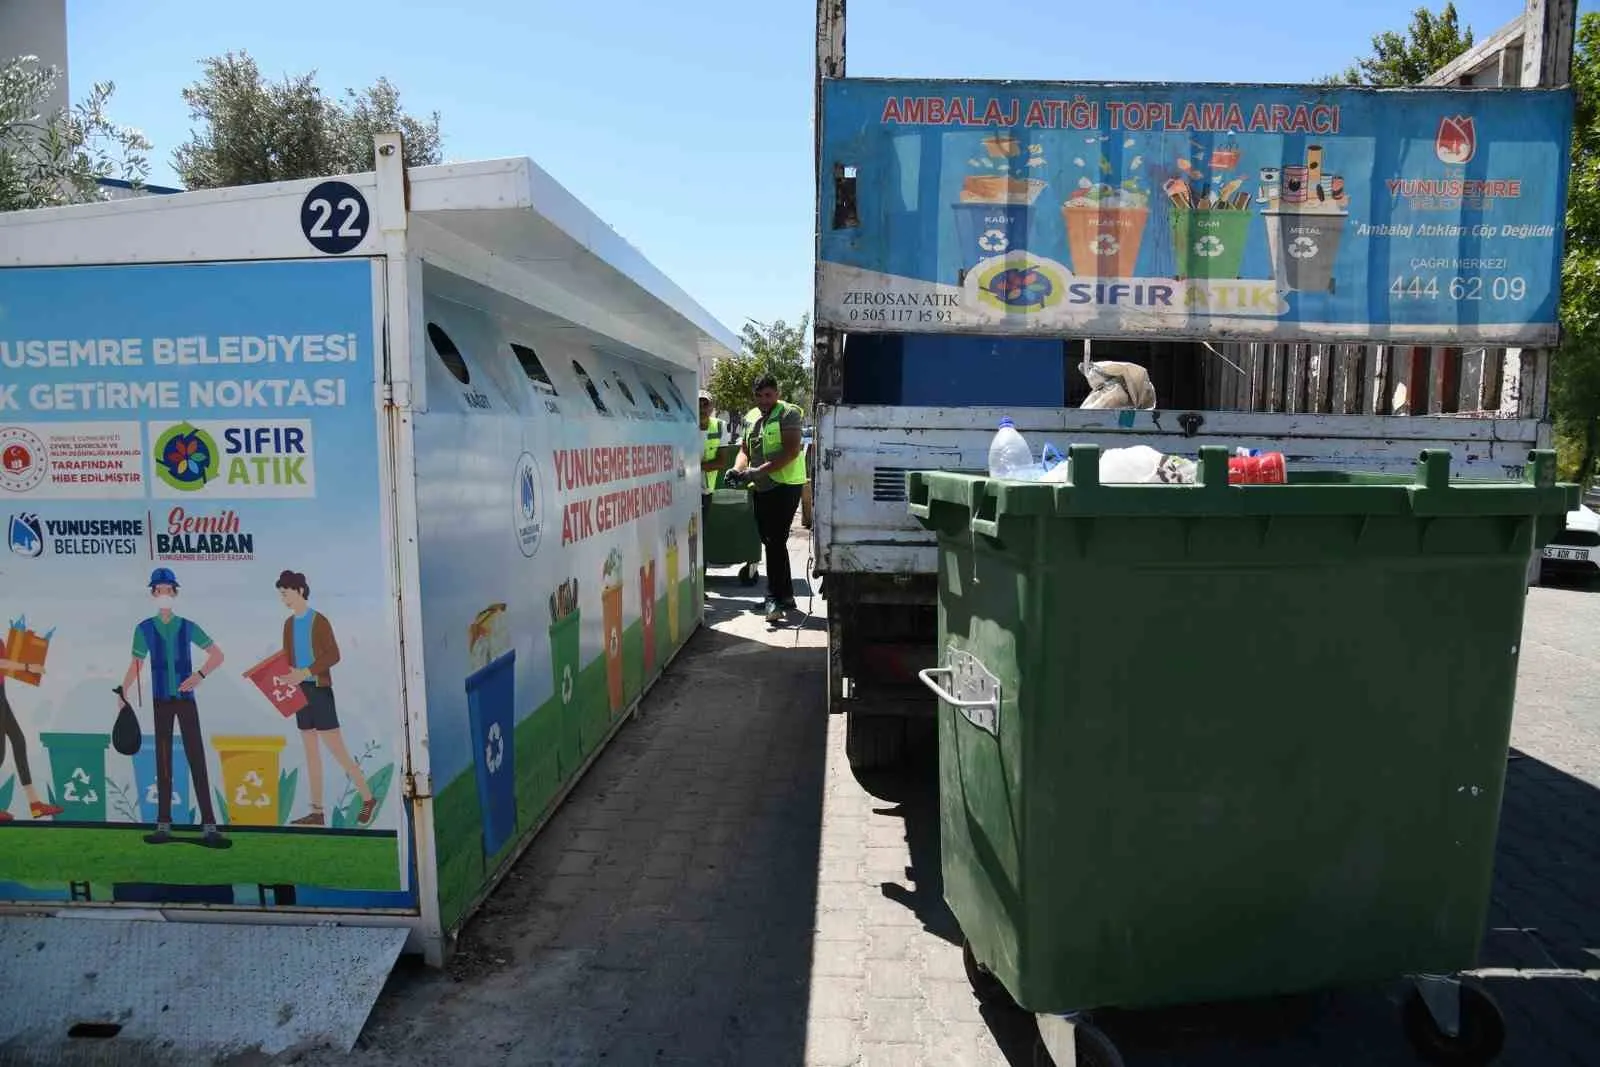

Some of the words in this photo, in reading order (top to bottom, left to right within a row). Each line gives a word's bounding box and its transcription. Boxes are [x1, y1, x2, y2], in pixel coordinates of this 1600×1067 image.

[880, 96, 1020, 127] AMBALAJ
[1024, 95, 1098, 130] ATIĞI
[1107, 101, 1243, 133] TOPLAMA
[1248, 103, 1341, 134] ARACI
[1386, 179, 1521, 198] YUNUSEMRE
[308, 198, 362, 238] 22
[843, 291, 920, 306] ZEROSAN
[922, 293, 960, 306] ATIK
[1069, 283, 1174, 306] SIFIR
[1184, 286, 1277, 307] ATIK
[1390, 275, 1440, 300] 444
[1449, 276, 1482, 300] 62
[1492, 276, 1526, 301] 09
[862, 309, 885, 321] 505
[891, 310, 913, 321] 117
[936, 310, 952, 321] 93
[0, 338, 143, 368] USEMRE
[153, 333, 357, 365] BELEDİYESİ
[29, 380, 180, 411] GETİRME
[190, 378, 346, 408] NOKTASI
[225, 427, 305, 454] SIFIR
[52, 460, 123, 470] TARAFINDAN
[52, 473, 78, 483] HİBE
[81, 471, 141, 483] EDİLMİŞTİR
[227, 456, 307, 485] ATIK
[553, 445, 630, 492] YUNUSEMRE
[46, 519, 143, 536] YUNUSEMRE
[168, 507, 240, 535] Semih
[562, 498, 594, 548] ATIK
[55, 537, 136, 555] BELEDİYESİ
[157, 533, 254, 553] BALABAN
